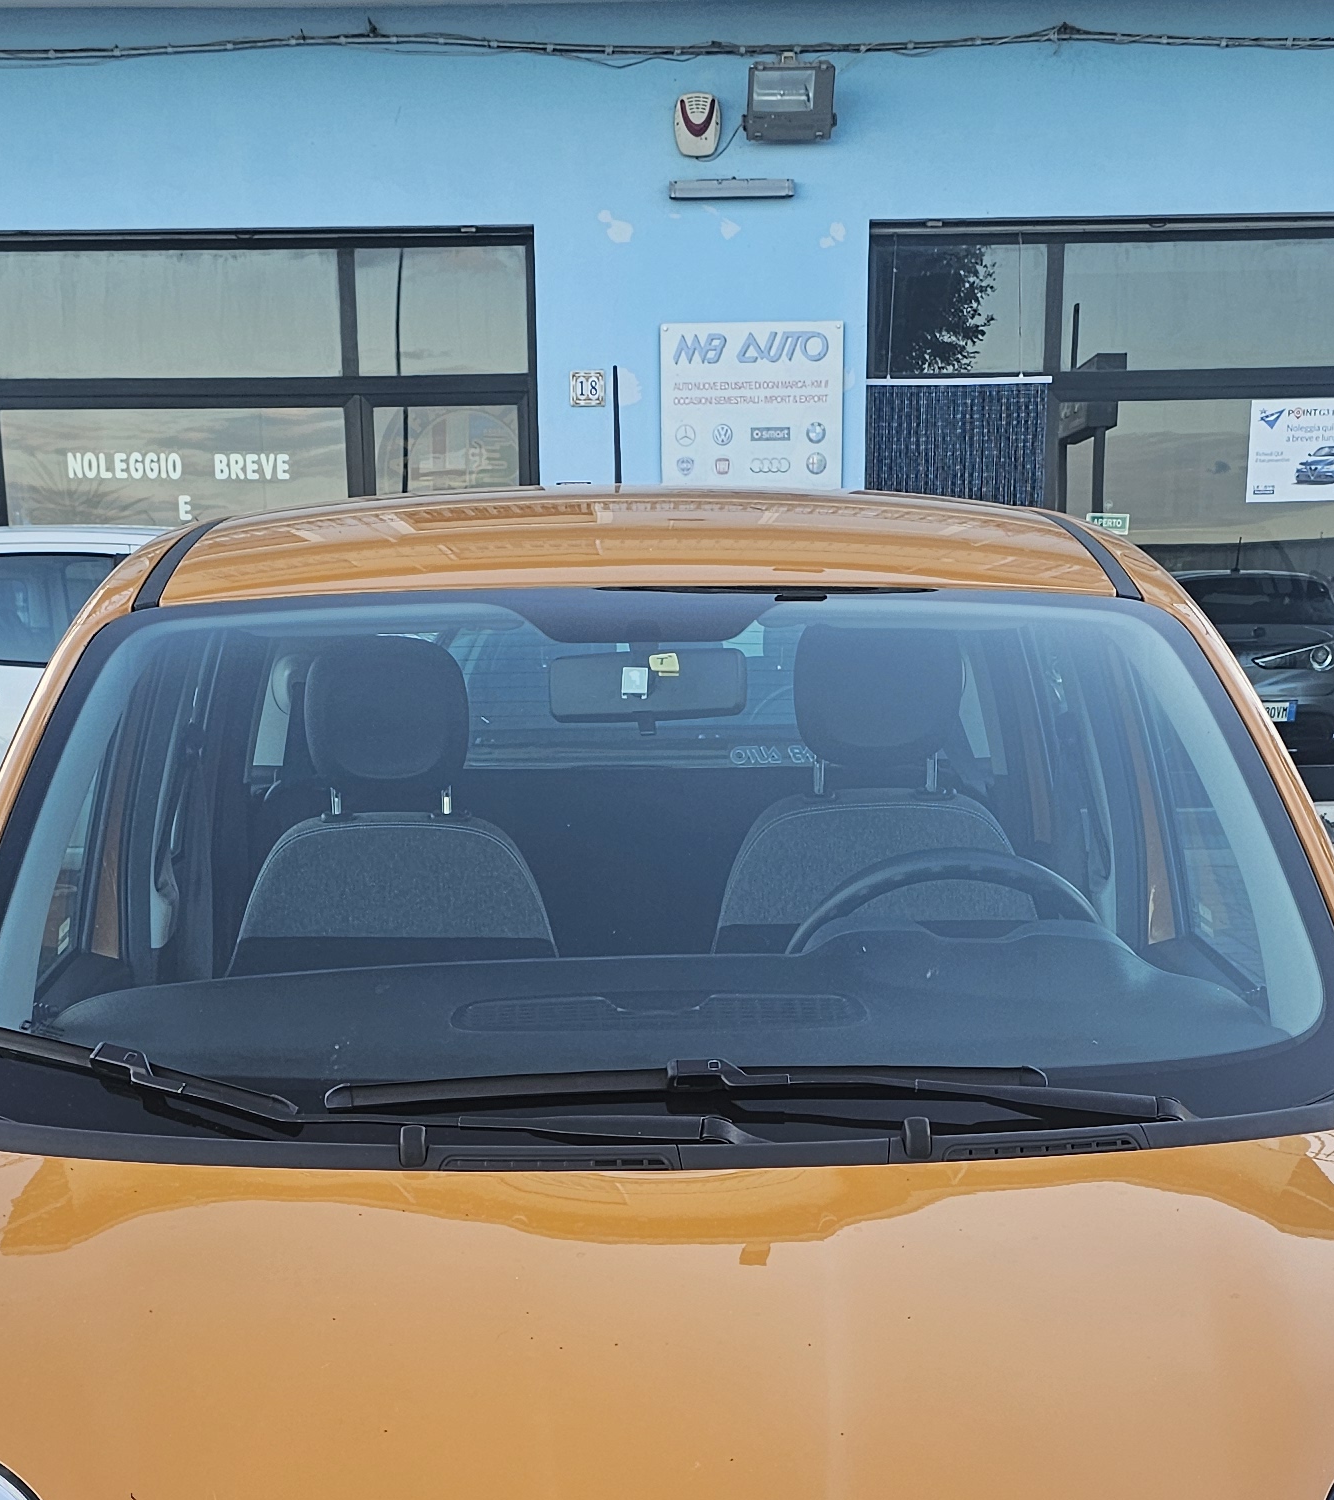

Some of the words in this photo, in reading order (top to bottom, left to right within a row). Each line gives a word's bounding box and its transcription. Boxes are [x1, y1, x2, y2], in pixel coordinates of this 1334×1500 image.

[673, 333, 727, 365] MB
[736, 331, 829, 363] AUTO
[579, 380, 598, 396] 18
[673, 382, 692, 391] AUTO
[694, 381, 719, 391] NUOVE
[731, 381, 754, 390] USATE
[780, 380, 808, 389] MARCA
[714, 395, 760, 405] SEMESTRALI
[764, 395, 792, 405] IMPORT
[799, 394, 829, 404] EXPORT
[762, 429, 789, 438] smart
[1287, 424, 1320, 433] Noleggia
[1322, 424, 1334, 432] qui
[1292, 434, 1314, 442] breve
[67, 452, 182, 480] NOLEGGIO
[214, 453, 291, 480] BREVE
[178, 495, 193, 521] E
[1093, 518, 1123, 528] APERTO
